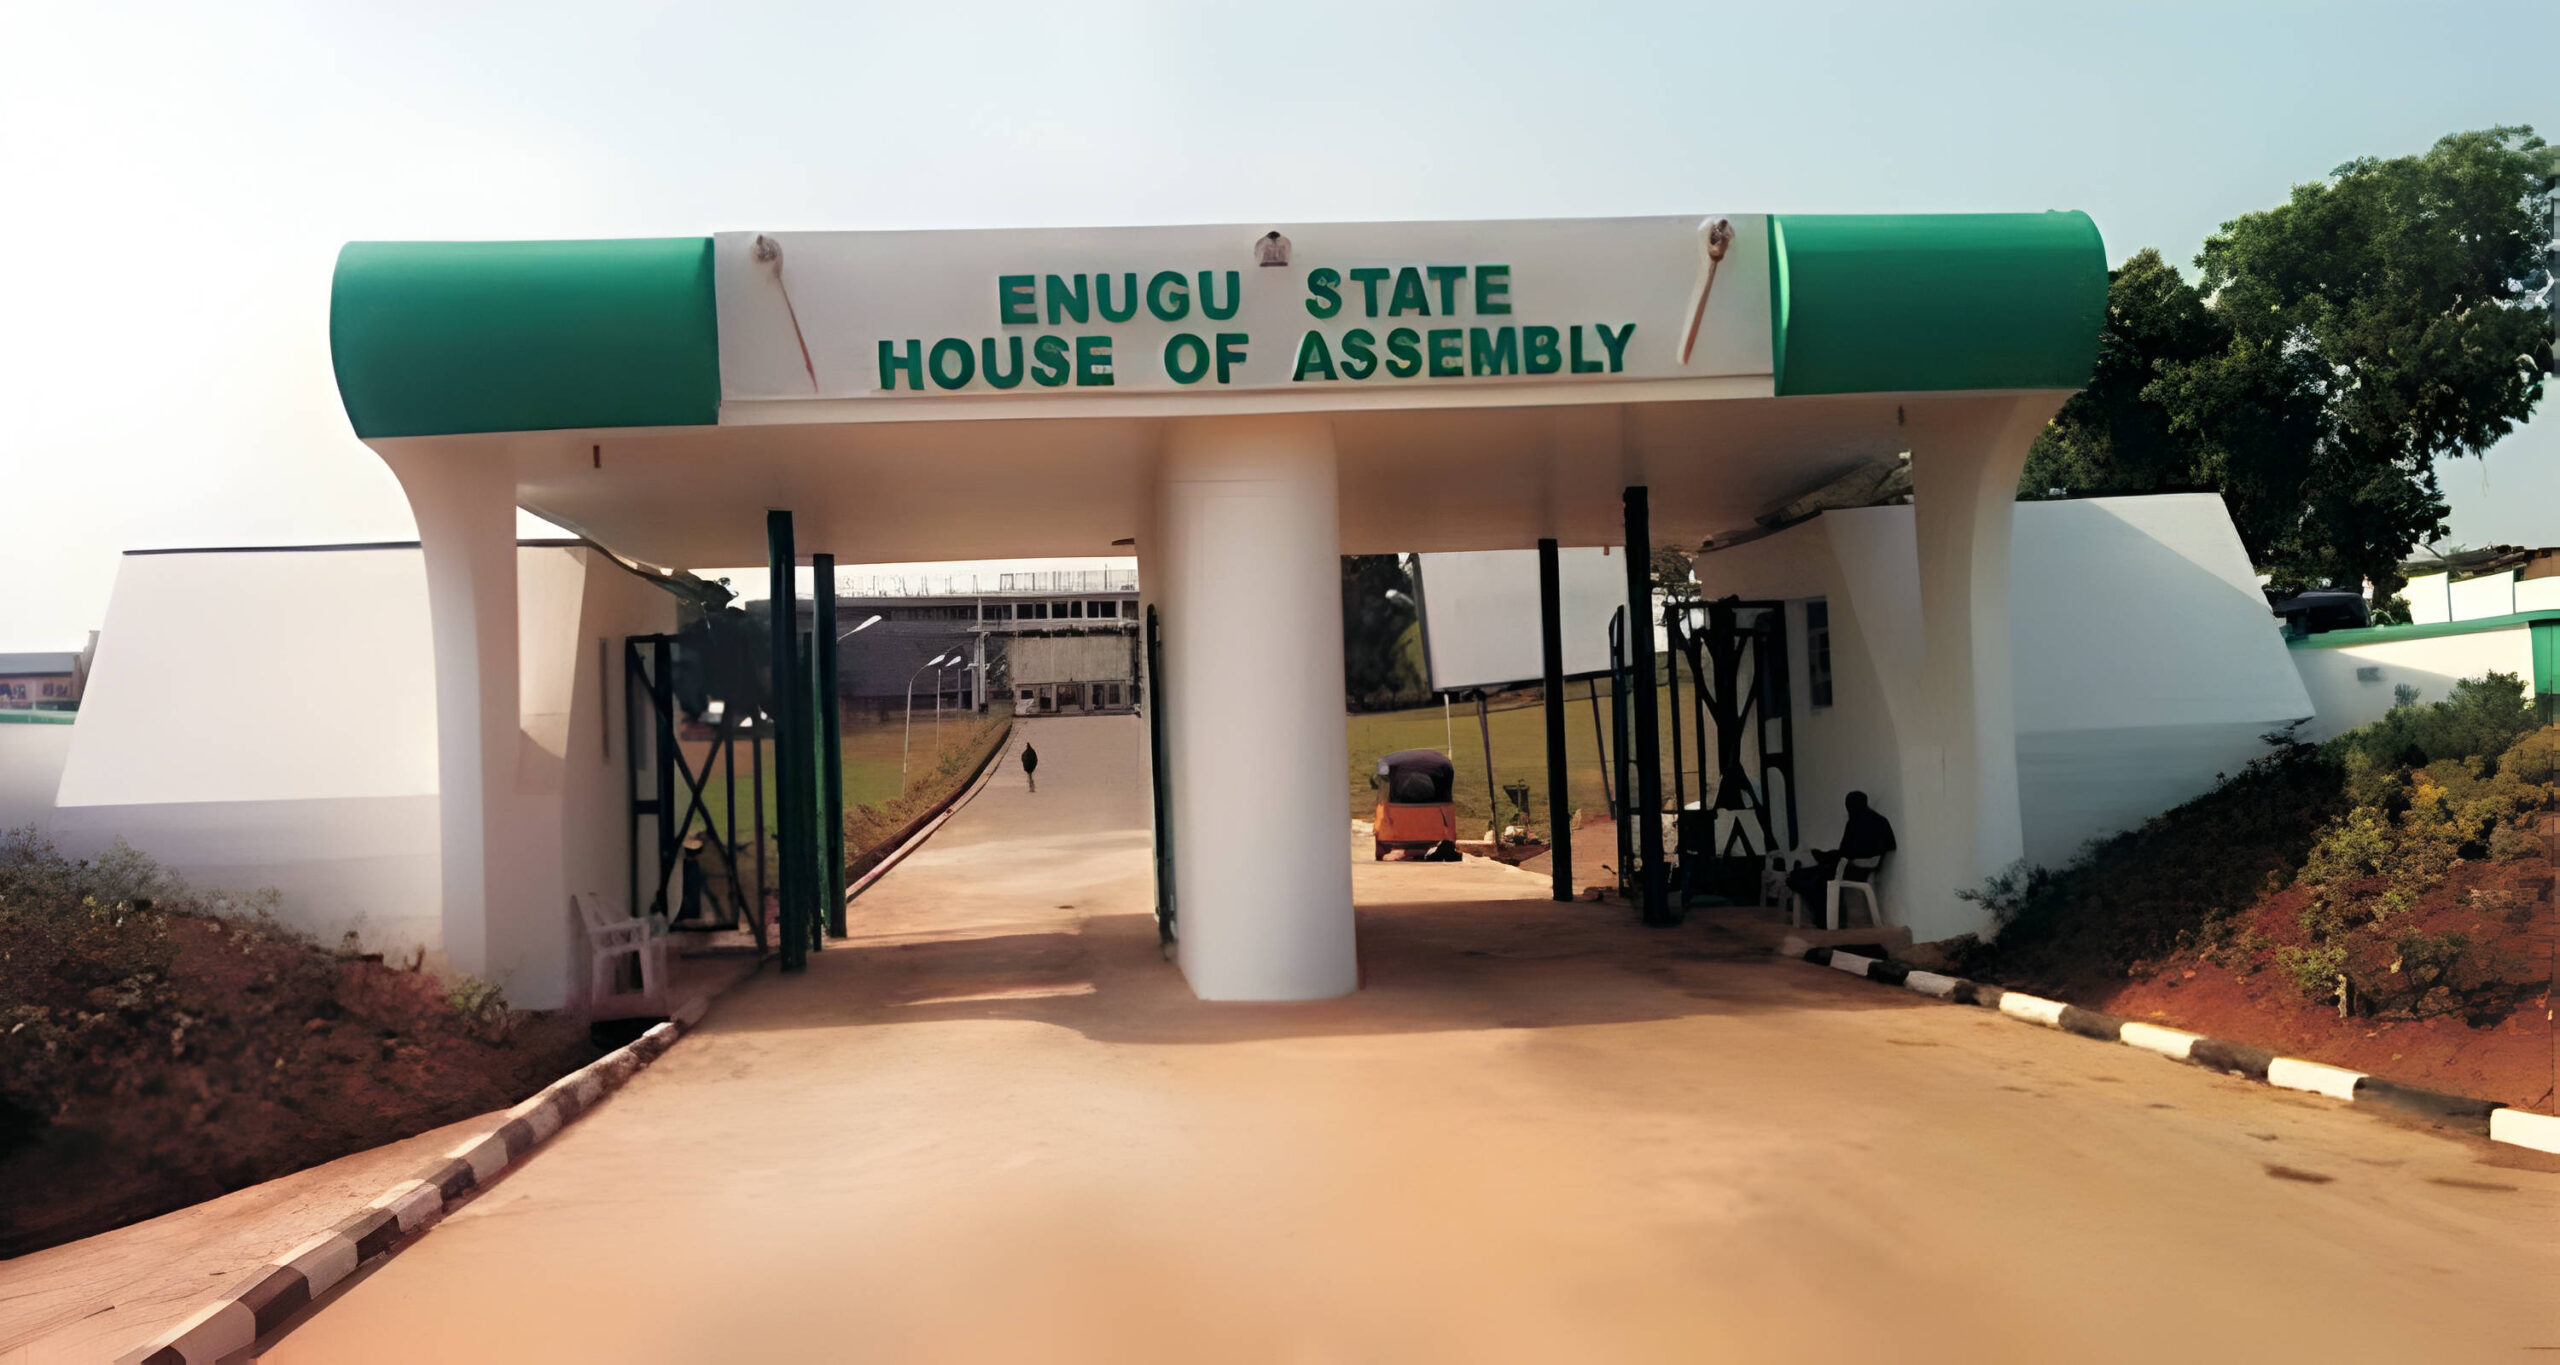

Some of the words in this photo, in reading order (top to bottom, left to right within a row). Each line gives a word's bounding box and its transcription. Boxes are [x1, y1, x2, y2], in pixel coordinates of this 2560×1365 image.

[999, 271, 1241, 325] ENUGU
[1305, 265, 1512, 320] STATE
[878, 333, 1114, 390] HOUSE
[1164, 333, 1249, 384] OF
[1293, 323, 1637, 381] ASSEMBLY
